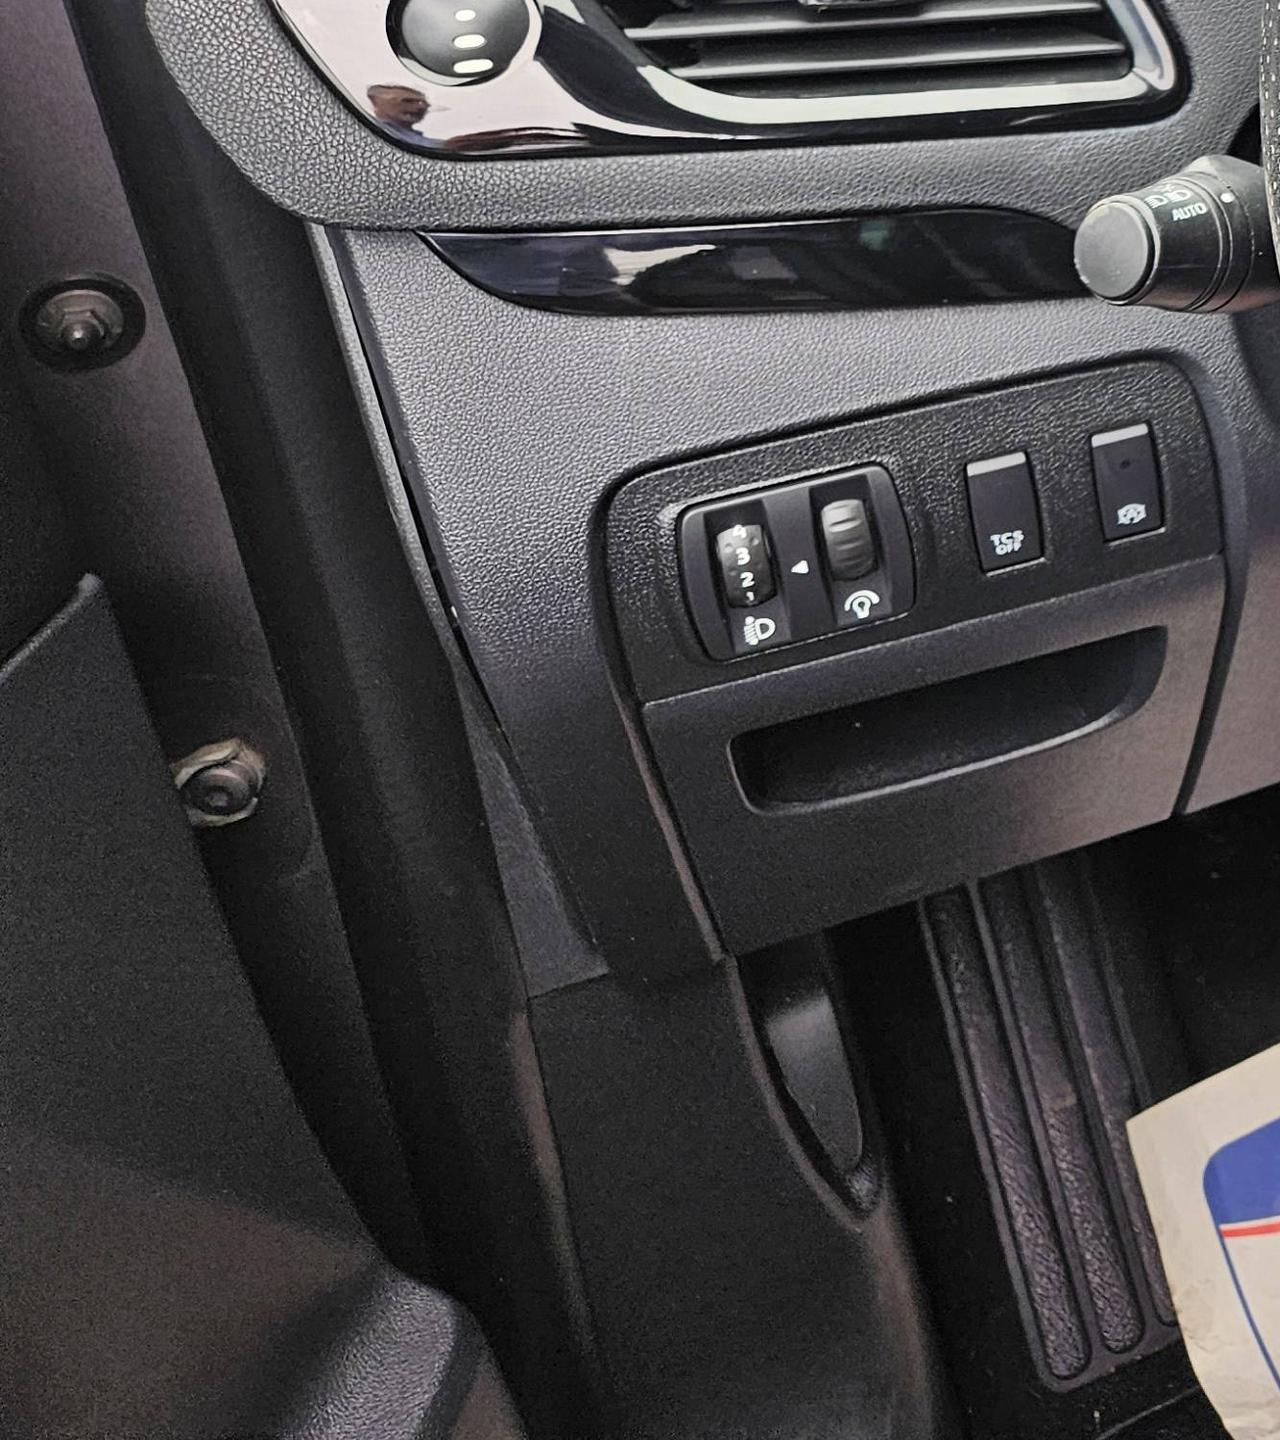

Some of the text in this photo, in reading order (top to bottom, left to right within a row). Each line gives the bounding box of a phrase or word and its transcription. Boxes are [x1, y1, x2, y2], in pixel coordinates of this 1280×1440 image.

[1171, 201, 1208, 222] AUTO
[732, 524, 748, 539] 4
[990, 530, 1025, 546] TCS
[735, 547, 751, 566] 3
[995, 541, 1023, 556] OFF
[740, 571, 756, 588] 2
[745, 591, 755, 602] 1
